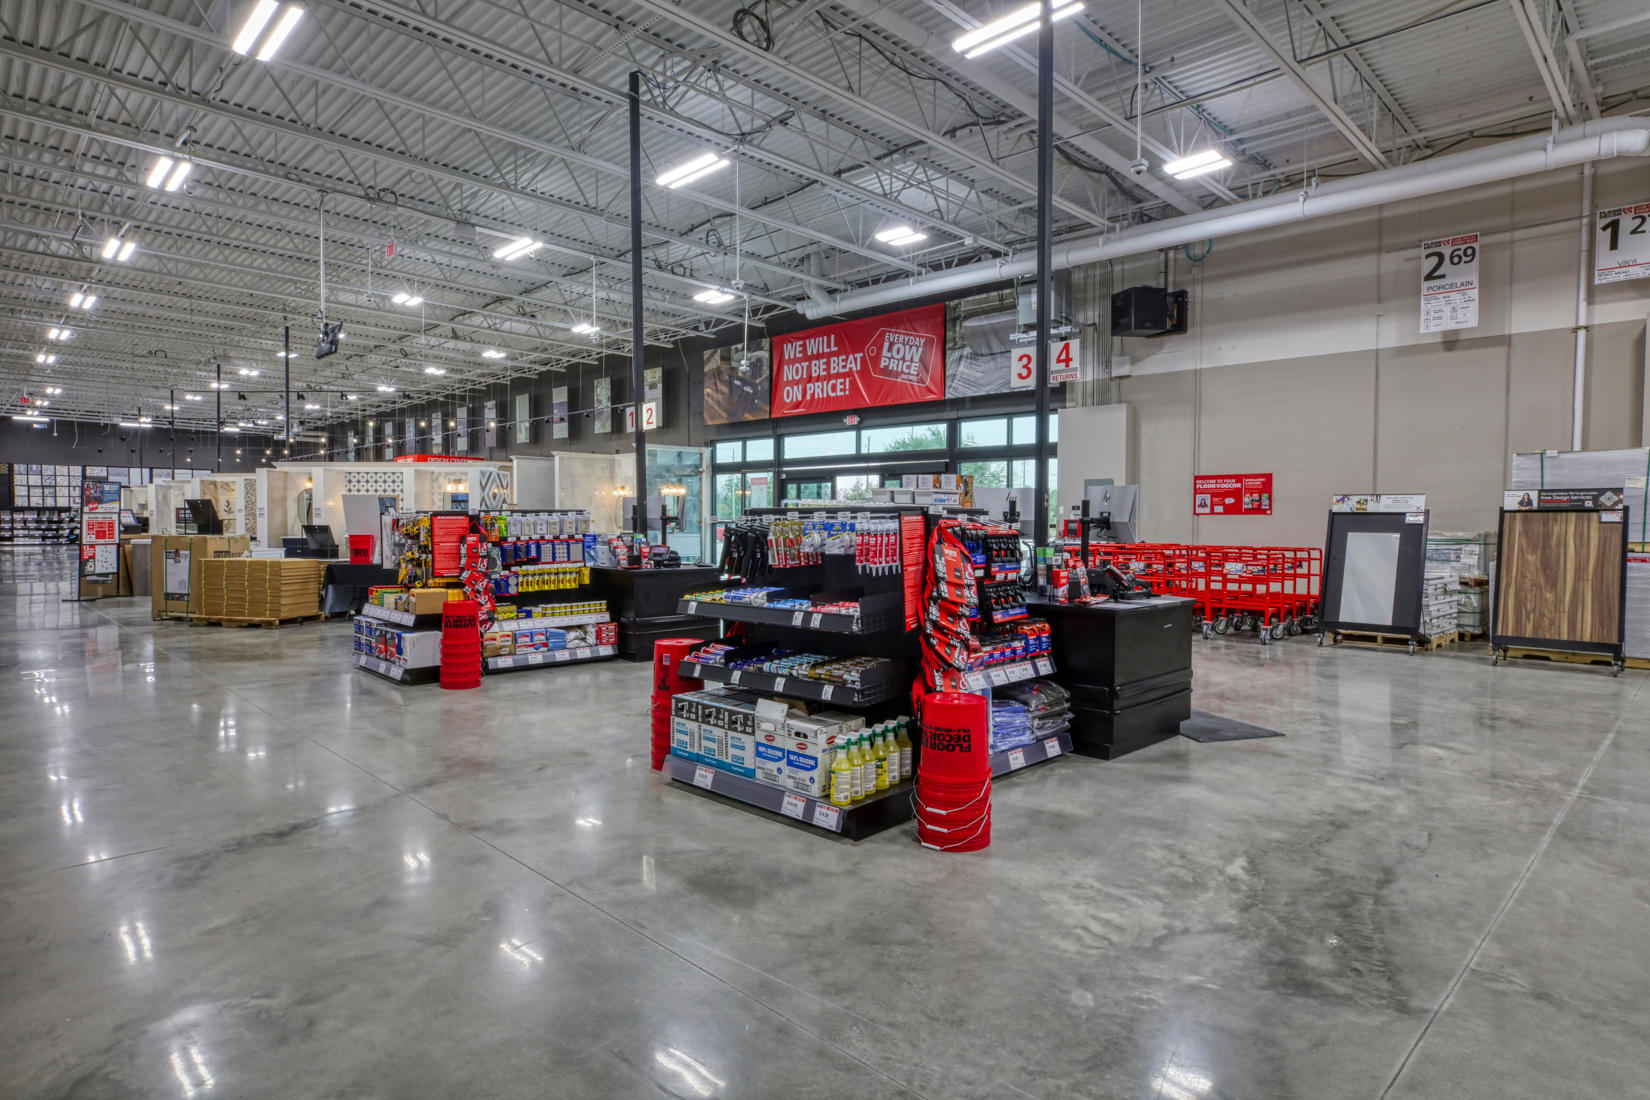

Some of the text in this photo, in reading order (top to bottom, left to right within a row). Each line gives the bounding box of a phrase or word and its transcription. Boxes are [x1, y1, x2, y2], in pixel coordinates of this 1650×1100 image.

[1427, 280, 1474, 292] PORCELAIN
[783, 334, 838, 360] WE WILL
[885, 332, 926, 346] EVERYDAY
[882, 341, 922, 362] LOW
[1056, 342, 1073, 368] 4
[783, 352, 863, 381] NOT BE BEAT
[880, 356, 919, 375] PRICE
[1017, 353, 1032, 380] 3
[1052, 372, 1078, 382] RETURNS
[783, 385, 802, 402] ON
[629, 410, 634, 428] 1
[646, 407, 654, 425] 2
[930, 731, 971, 743] DECOR
[930, 743, 971, 752] FLOOR
